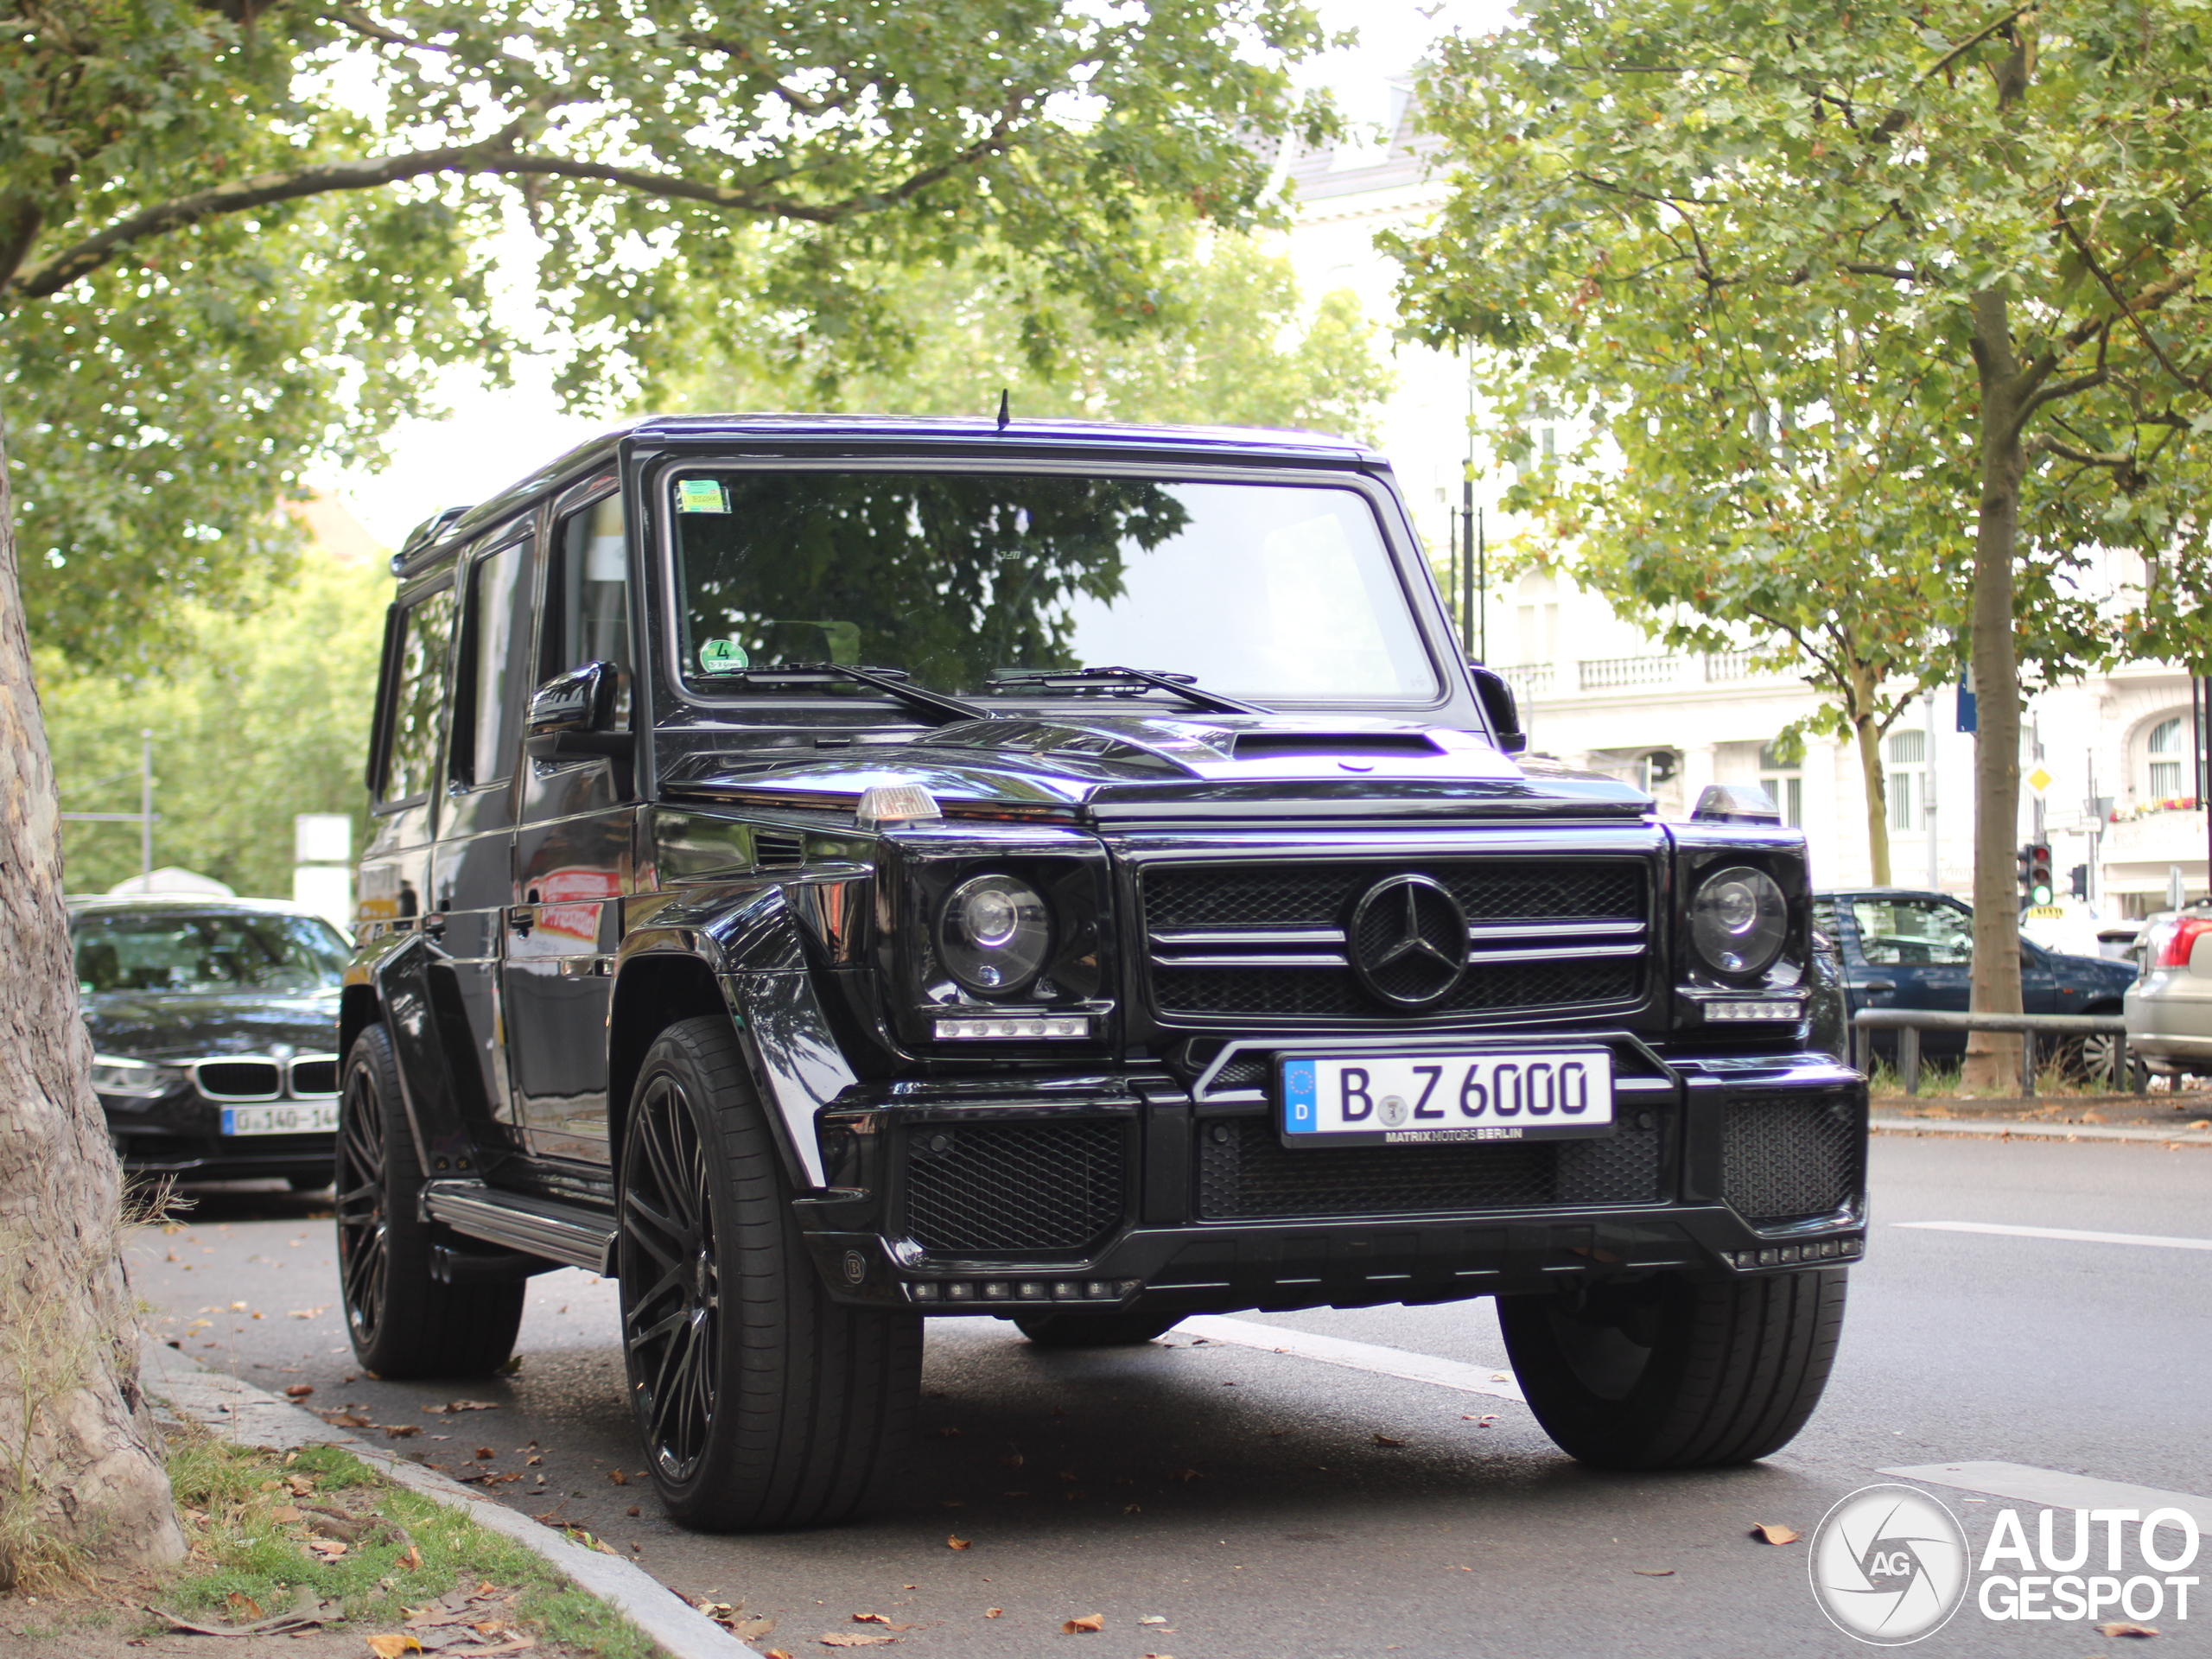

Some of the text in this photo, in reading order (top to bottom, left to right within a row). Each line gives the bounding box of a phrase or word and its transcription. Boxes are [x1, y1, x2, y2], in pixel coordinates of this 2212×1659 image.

[717, 642, 730, 659] 4
[1339, 1061, 1588, 1122] B Z 6000
[1295, 1104, 1308, 1120] D
